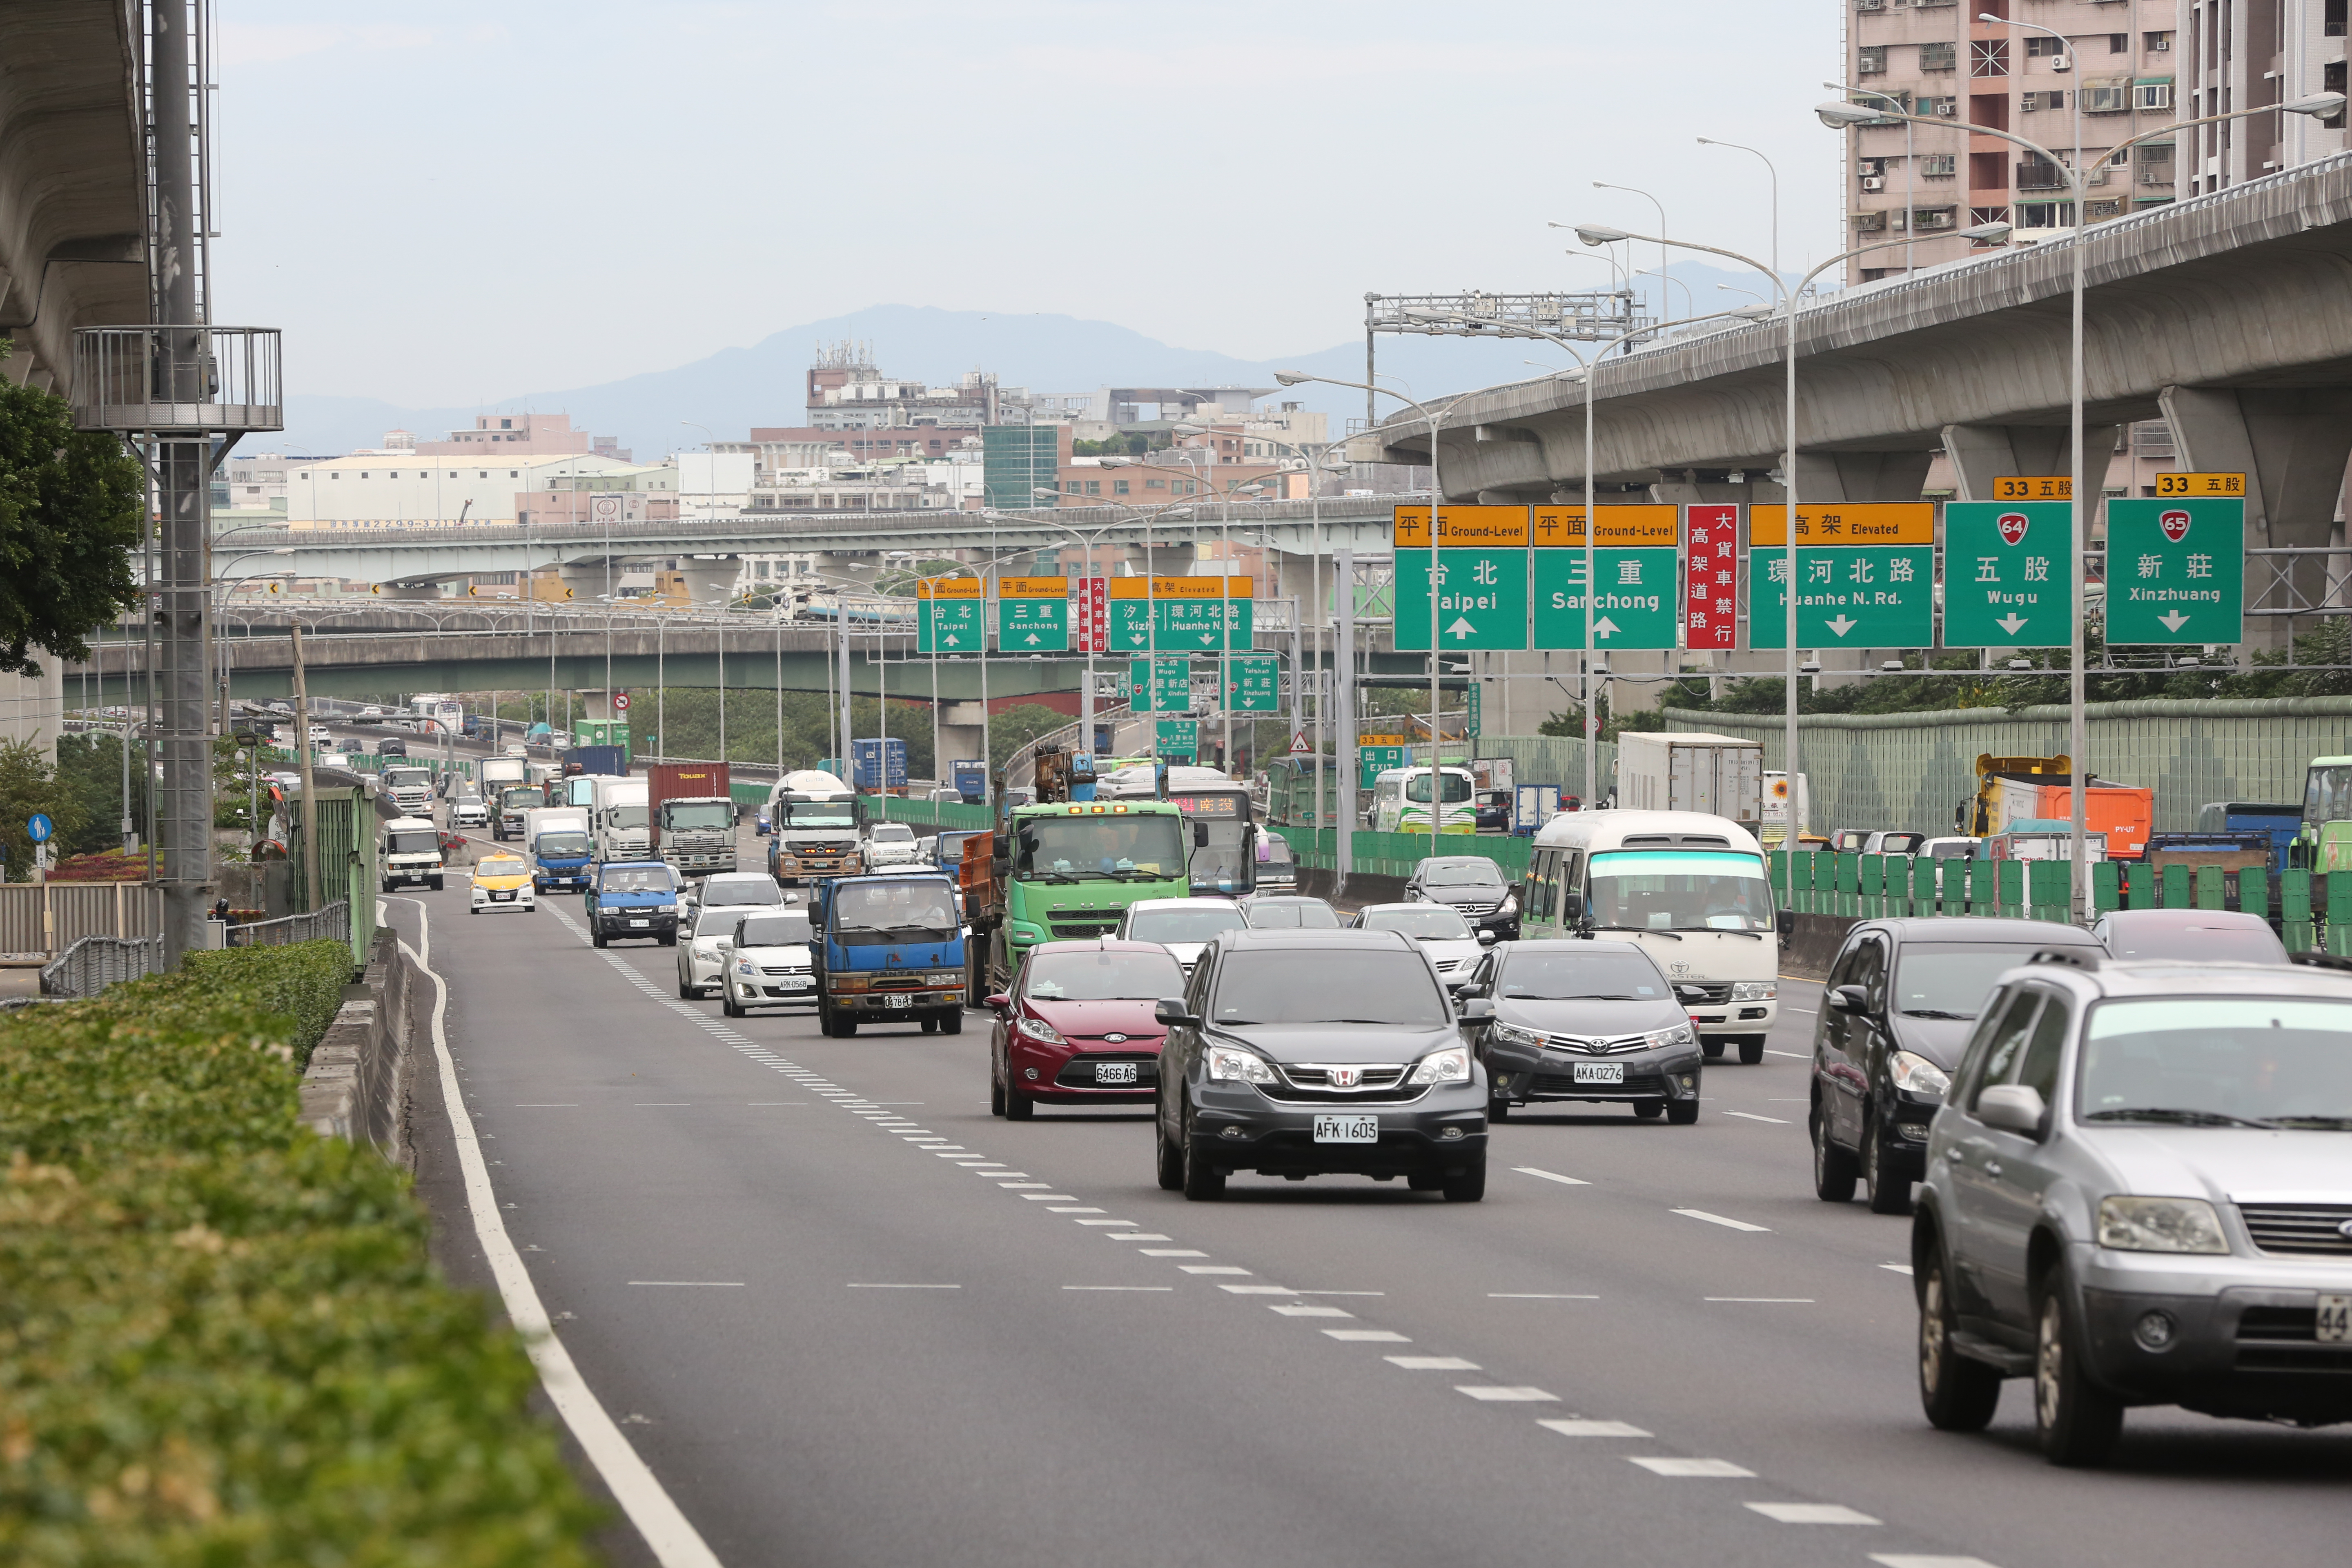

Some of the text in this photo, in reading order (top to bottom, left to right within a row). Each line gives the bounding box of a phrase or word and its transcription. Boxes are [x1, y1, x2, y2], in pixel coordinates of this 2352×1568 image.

[2004, 481, 2072, 496] 33 五股
[2163, 477, 2240, 492] 33 五股
[1399, 516, 1523, 537] 平面 Ground-Level
[1539, 516, 1673, 536] 平面 Ground-Level
[1795, 514, 1898, 535] 高架 Elevated
[2001, 520, 2024, 534] 64
[2164, 517, 2187, 531] 65
[1425, 560, 1498, 585] 台北
[1568, 559, 1644, 585] 三重
[1768, 558, 1914, 584] 環河北路
[1975, 557, 2050, 582] 五股
[2137, 553, 2213, 579] 新莊
[1690, 527, 1708, 629] 高架道路
[1715, 512, 1733, 643] 大貨車禁行
[920, 583, 945, 594] 平面
[1002, 582, 1027, 593] 平面
[1152, 582, 1175, 592] 高架
[1853, 592, 1870, 605] N.
[1875, 592, 1902, 605] Rd.
[1987, 591, 2038, 605] Wugu
[2129, 588, 2221, 603] Xinzhuang
[934, 605, 971, 619] 台北
[1014, 605, 1052, 618] 三重
[1080, 589, 1089, 641] 高架道路
[1094, 581, 1104, 648] 大貨車禁行
[1172, 605, 1240, 618] 環河北路
[938, 623, 968, 631] Taipei
[1009, 622, 1058, 630] Sanchong
[1172, 621, 1210, 630] Huanhe
[1213, 621, 1223, 630] N.
[1229, 621, 1241, 630] Rd.
[1168, 678, 1188, 688] 新店
[1243, 678, 1271, 688] 新莊
[1365, 750, 1397, 761] 出口
[1200, 798, 1234, 812] 南投
[885, 998, 911, 1007] 0478-PC
[1097, 1068, 1136, 1080] 6466-A6
[1576, 1067, 1622, 1080] AKA-0276
[1316, 1122, 1376, 1138] AFK-1603
